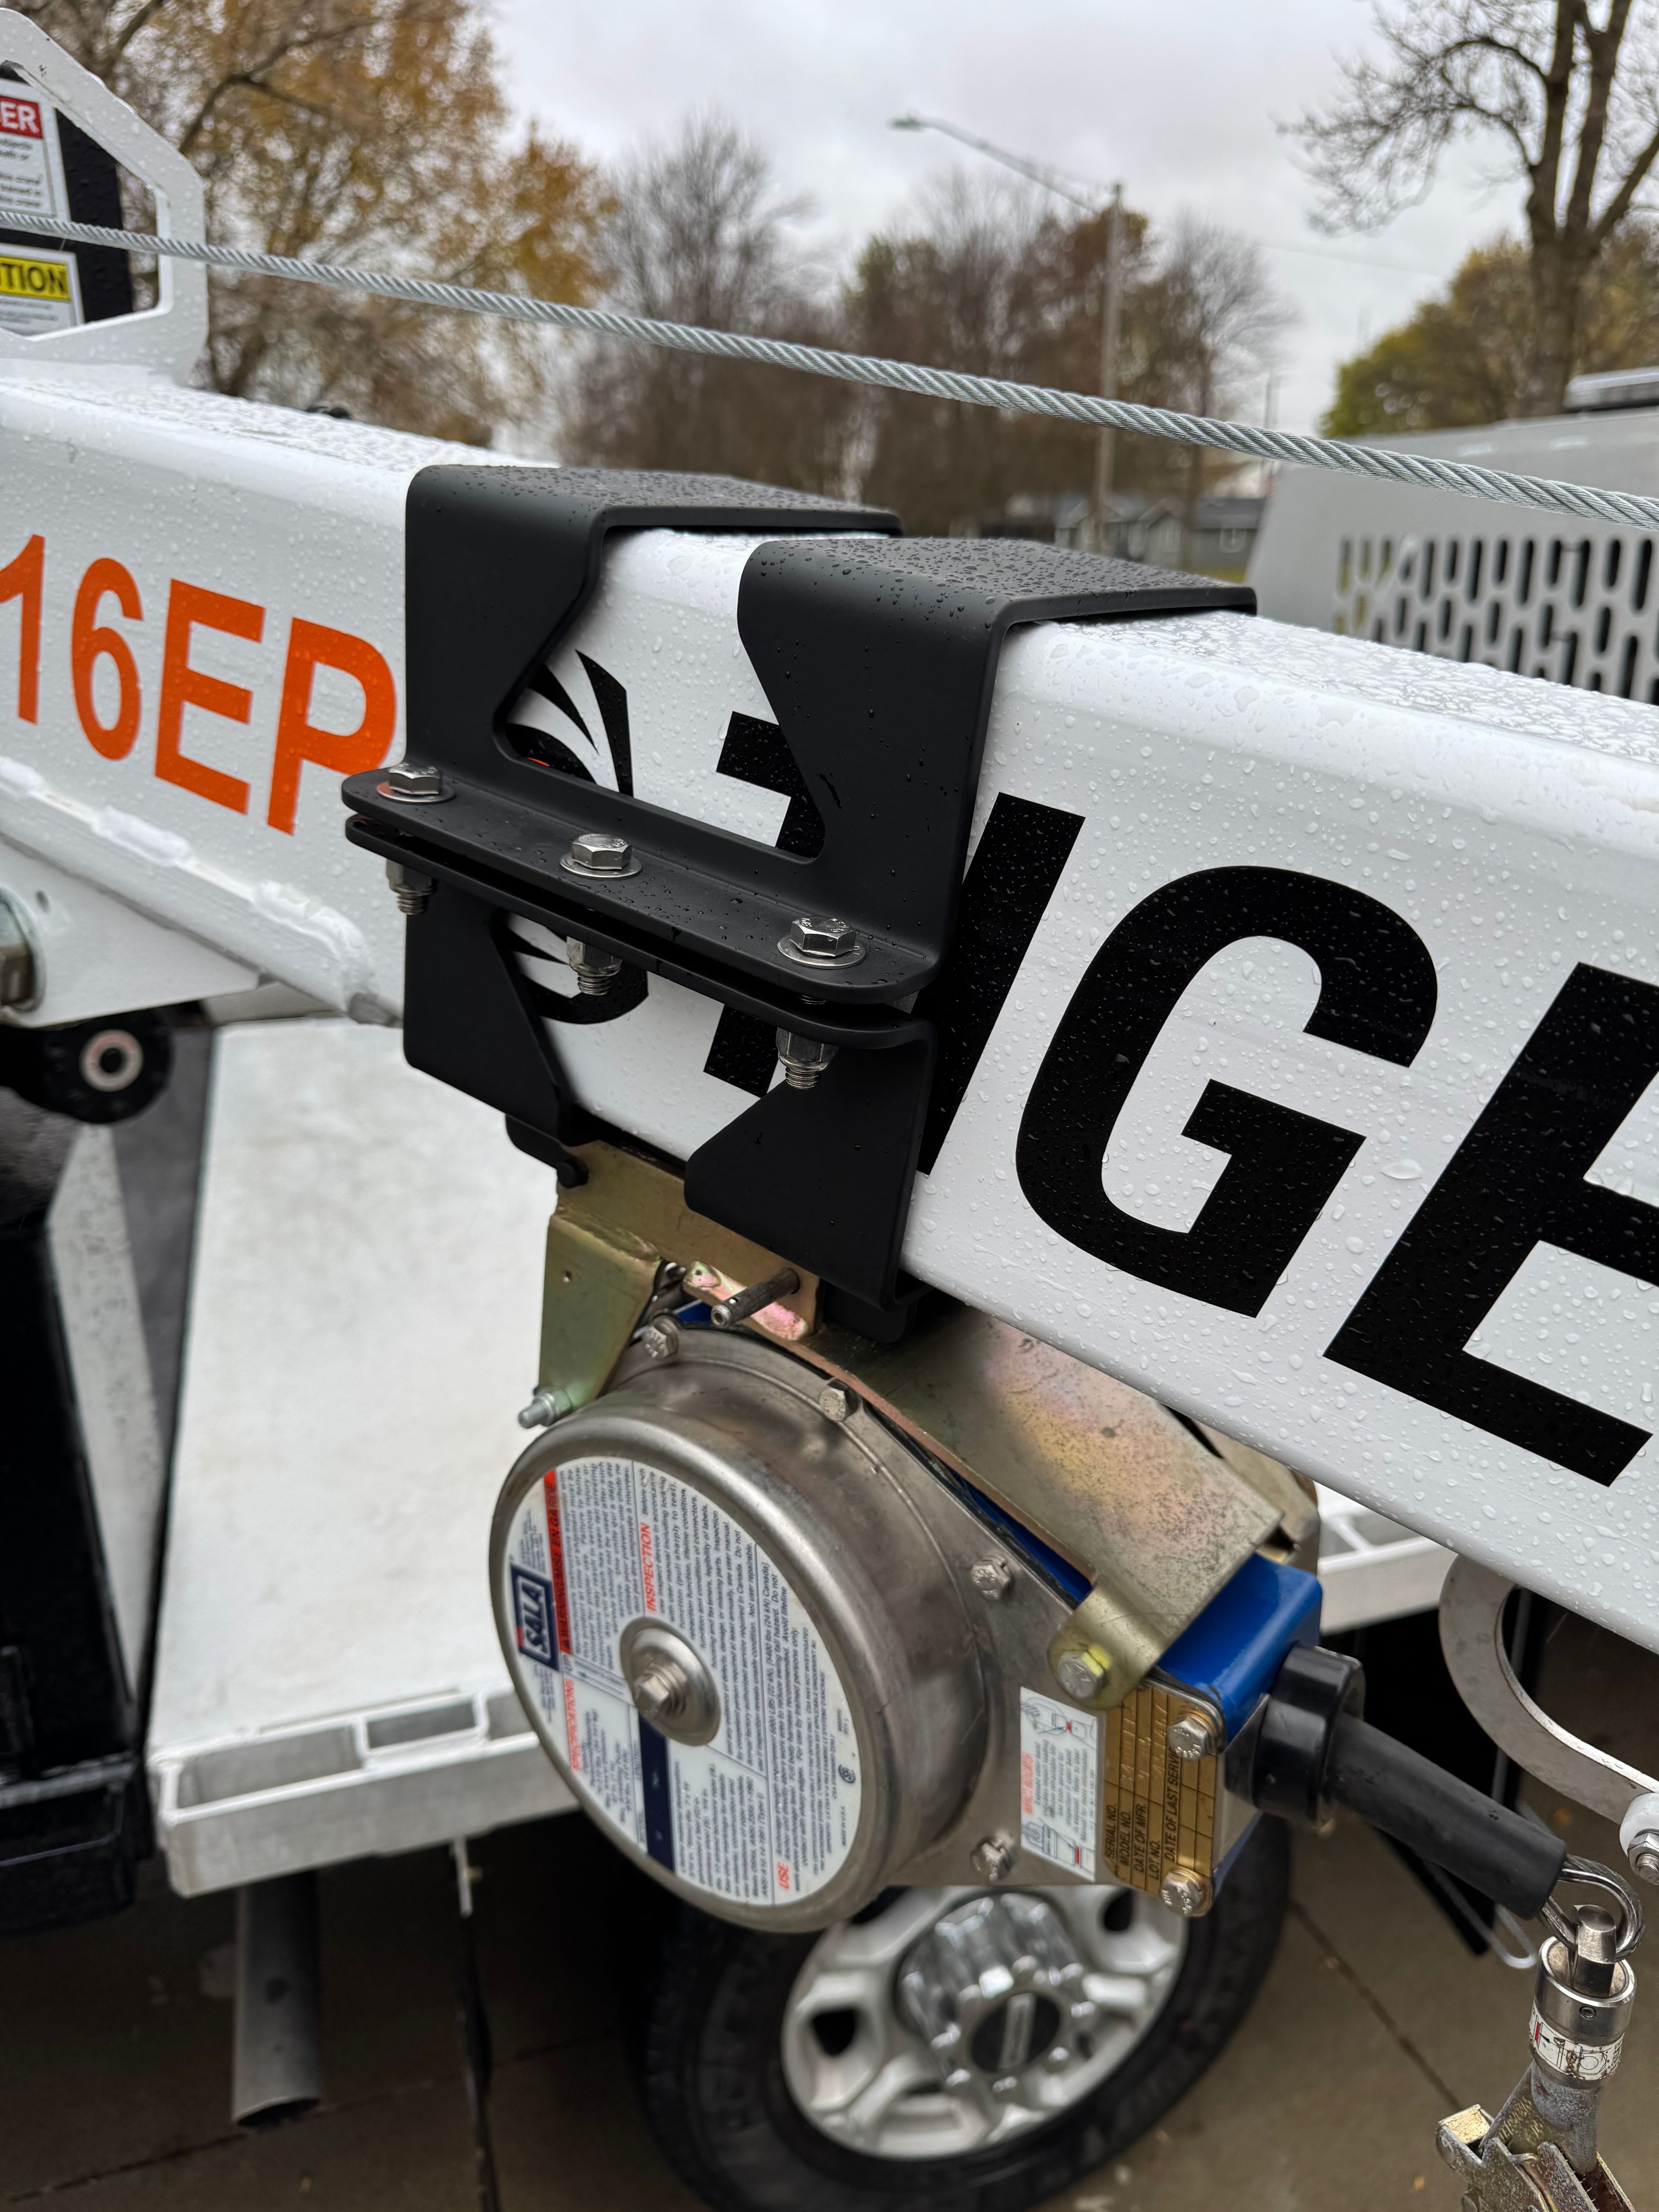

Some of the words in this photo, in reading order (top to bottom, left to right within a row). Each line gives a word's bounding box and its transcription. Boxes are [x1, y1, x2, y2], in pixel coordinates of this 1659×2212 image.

[0, 101, 39, 133] ER
[0, 263, 66, 295] TION
[544, 1482, 559, 1526] GARDE
[680, 1486, 689, 1530] condition,
[691, 1493, 700, 1545] connectors,
[548, 1528, 561, 1547] EN
[713, 1510, 721, 1553] Inspection
[641, 1523, 655, 1611] INSPECTION
[746, 1541, 754, 1583] repairable.
[520, 1581, 547, 1653] SALA
[1106, 1802, 1116, 1820] NO.
[1135, 1802, 1146, 1827] MFR.
[1166, 1785, 1177, 1815] LAST
[1120, 1809, 1131, 1828] NO.
[1165, 1814, 1175, 1831] OF
[1104, 1821, 1115, 1859] SERIAL
[1118, 1830, 1130, 1867] MODEL
[1134, 1826, 1146, 1844] OF
[1149, 1839, 1160, 1857] NO.
[1164, 1832, 1175, 1861] DATE
[1133, 1844, 1144, 1873] DATE
[1147, 1856, 1159, 1880] LOT
[777, 1862, 789, 1889] USE
